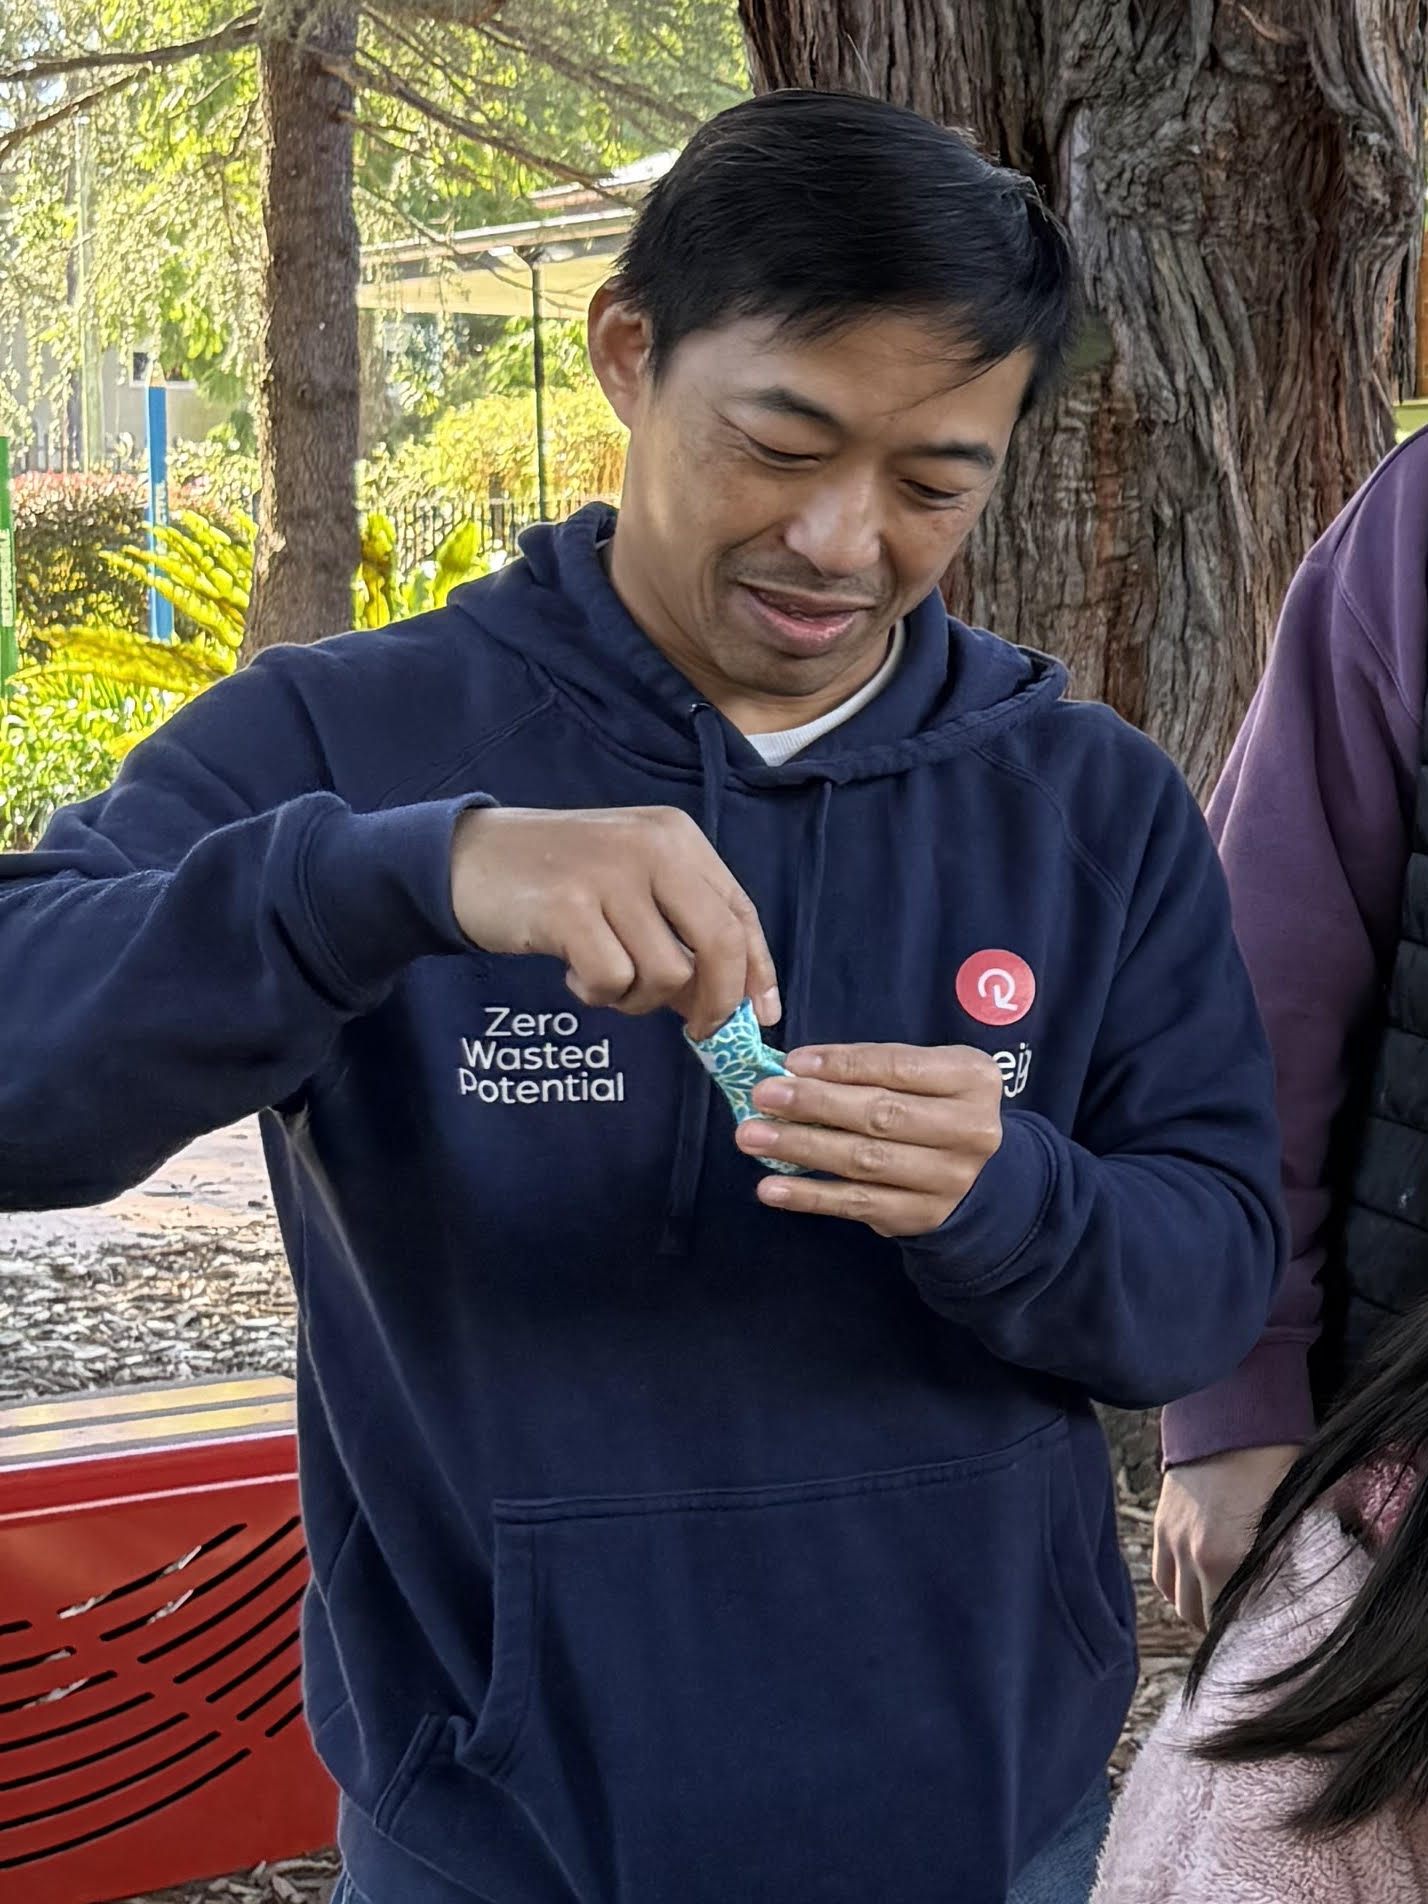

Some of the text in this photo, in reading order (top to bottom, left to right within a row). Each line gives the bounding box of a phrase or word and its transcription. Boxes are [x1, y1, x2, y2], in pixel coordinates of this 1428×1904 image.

[485, 1007, 579, 1037] Zero
[462, 1037, 610, 1070] Wasted
[458, 1068, 625, 1104] Potential
